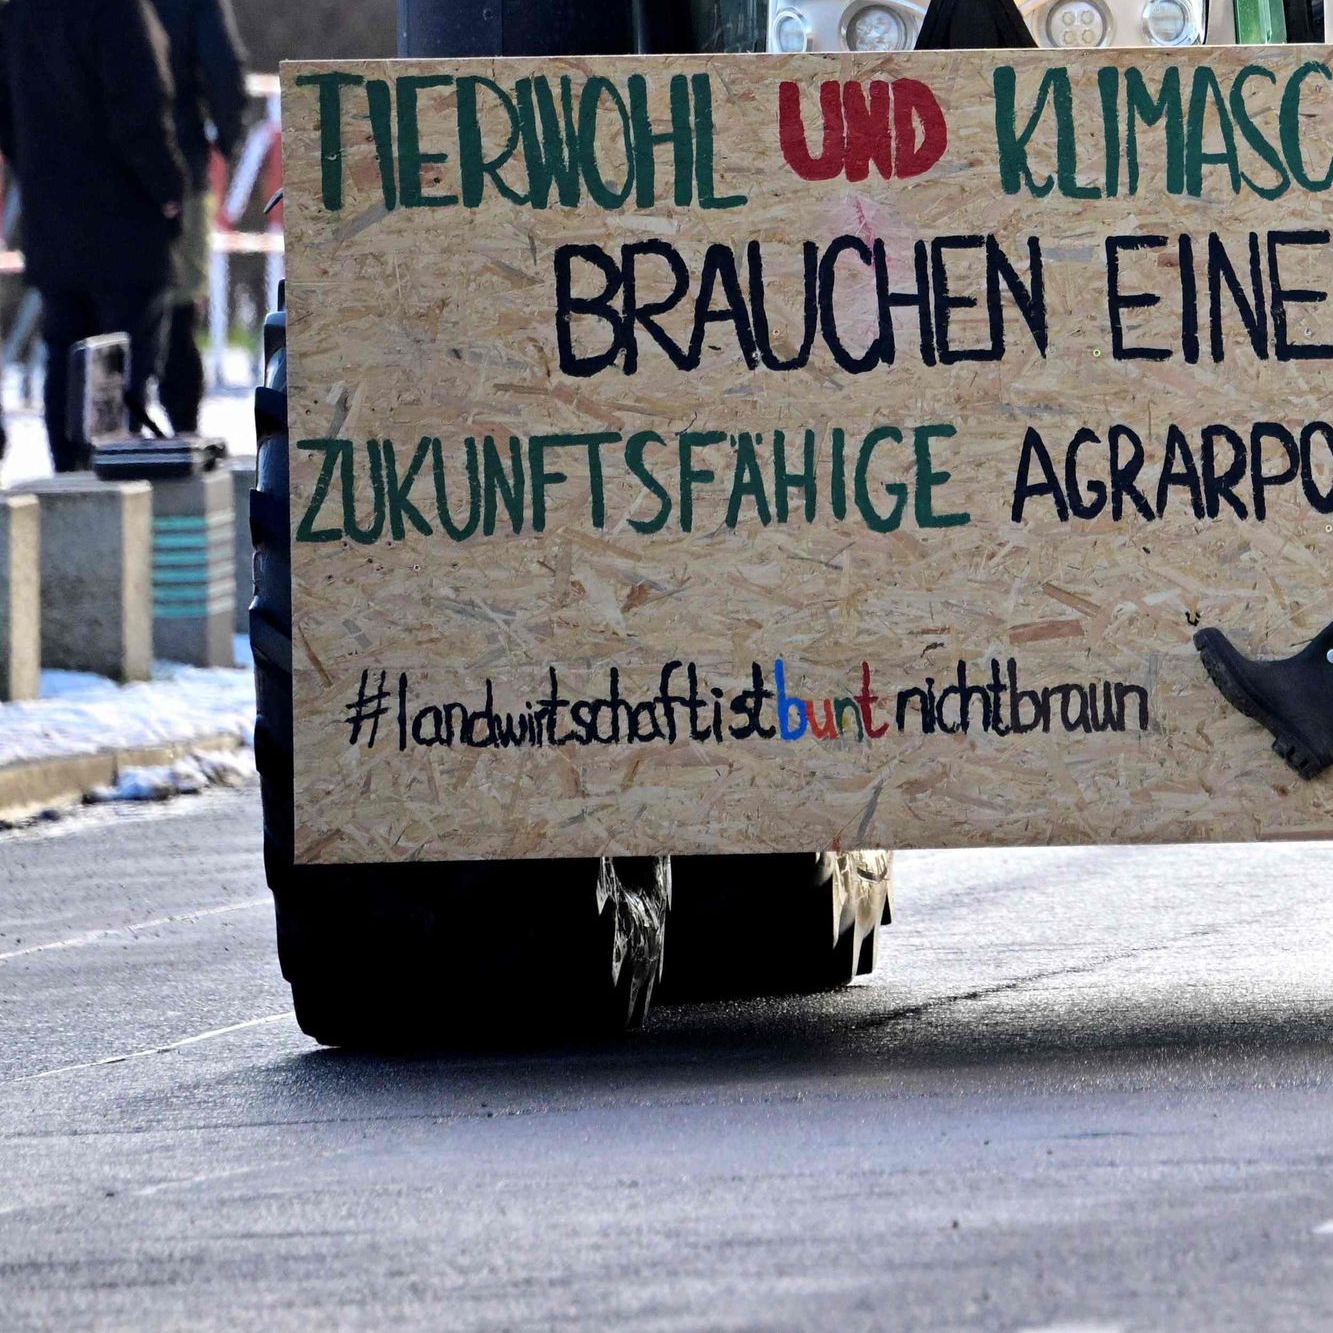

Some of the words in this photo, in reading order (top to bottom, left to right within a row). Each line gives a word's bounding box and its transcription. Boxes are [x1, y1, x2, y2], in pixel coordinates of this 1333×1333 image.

[295, 71, 748, 213] TIERWOHL
[778, 77, 948, 182] UND
[554, 234, 1049, 377] BRAUCHEN
[294, 422, 971, 545] ZUKUNFTSFÄHIGE
